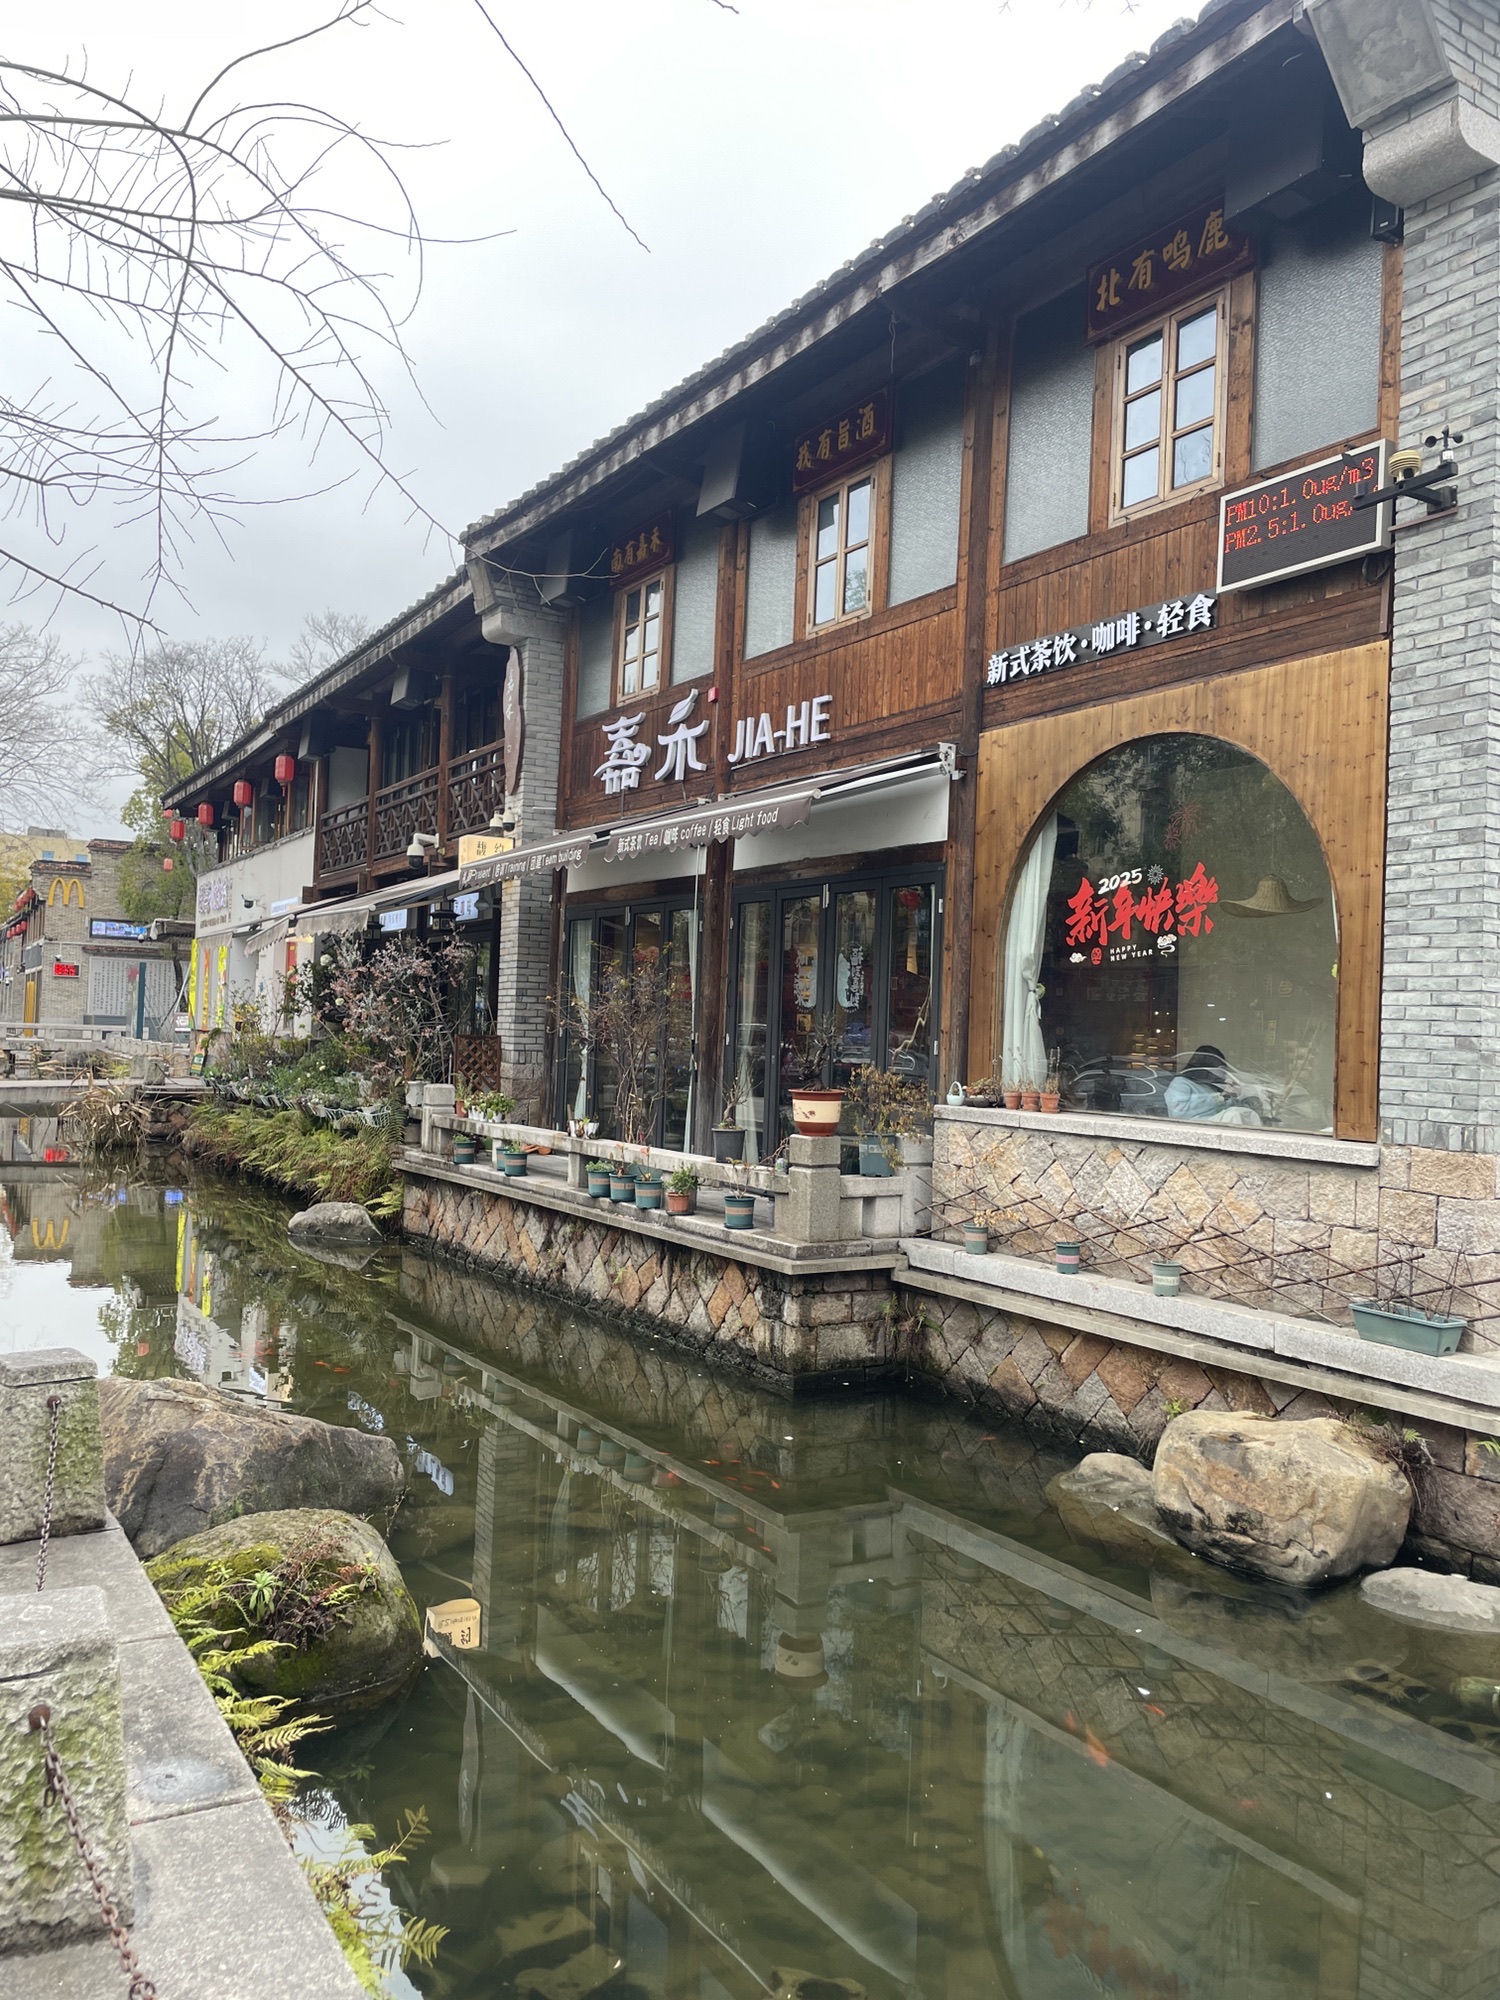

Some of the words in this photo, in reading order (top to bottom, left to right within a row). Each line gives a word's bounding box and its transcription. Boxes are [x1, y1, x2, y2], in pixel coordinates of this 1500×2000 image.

[593, 688, 709, 794] 嘉禾
[727, 694, 833, 763] JIA-HE
[680, 825, 707, 840] coffee
[731, 814, 755, 831] Light
[757, 807, 779, 824] food
[1098, 868, 1142, 894] 2025
[1110, 944, 1137, 954] HAPPY
[1110, 953, 1127, 962] NEW
[1131, 949, 1153, 958] YEAR
